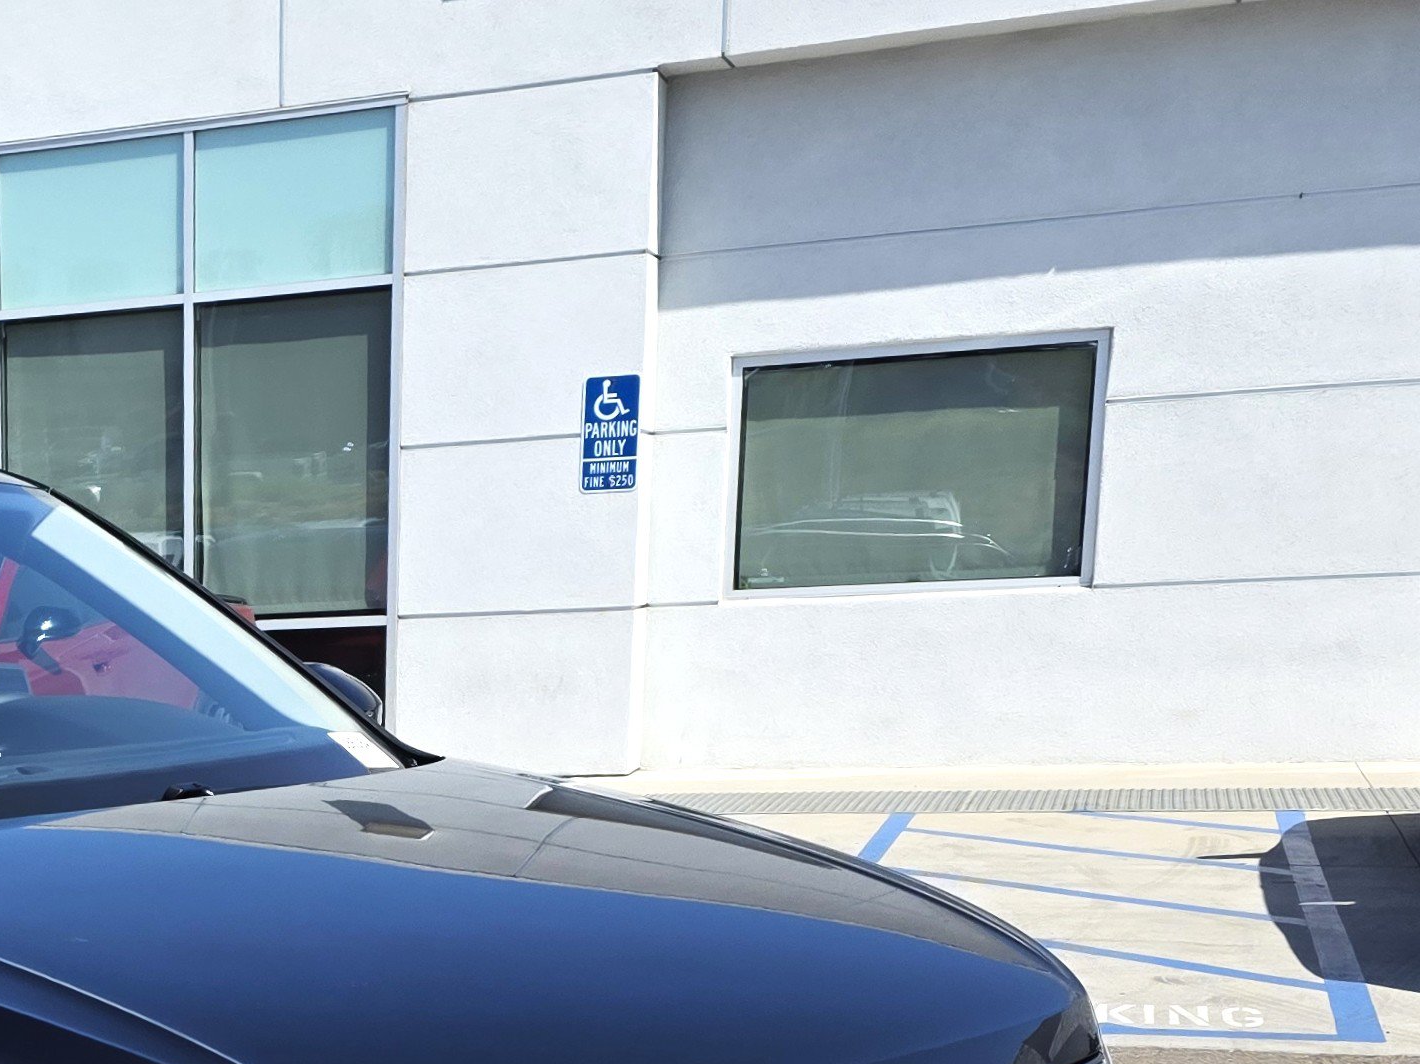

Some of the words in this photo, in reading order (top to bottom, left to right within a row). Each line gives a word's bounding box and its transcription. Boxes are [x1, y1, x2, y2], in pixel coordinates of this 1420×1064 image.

[584, 420, 637, 439] PARKING
[594, 439, 626, 457] ONLY
[589, 461, 629, 475] MINIMUM
[584, 476, 604, 488] FINE
[609, 474, 634, 488] $250
